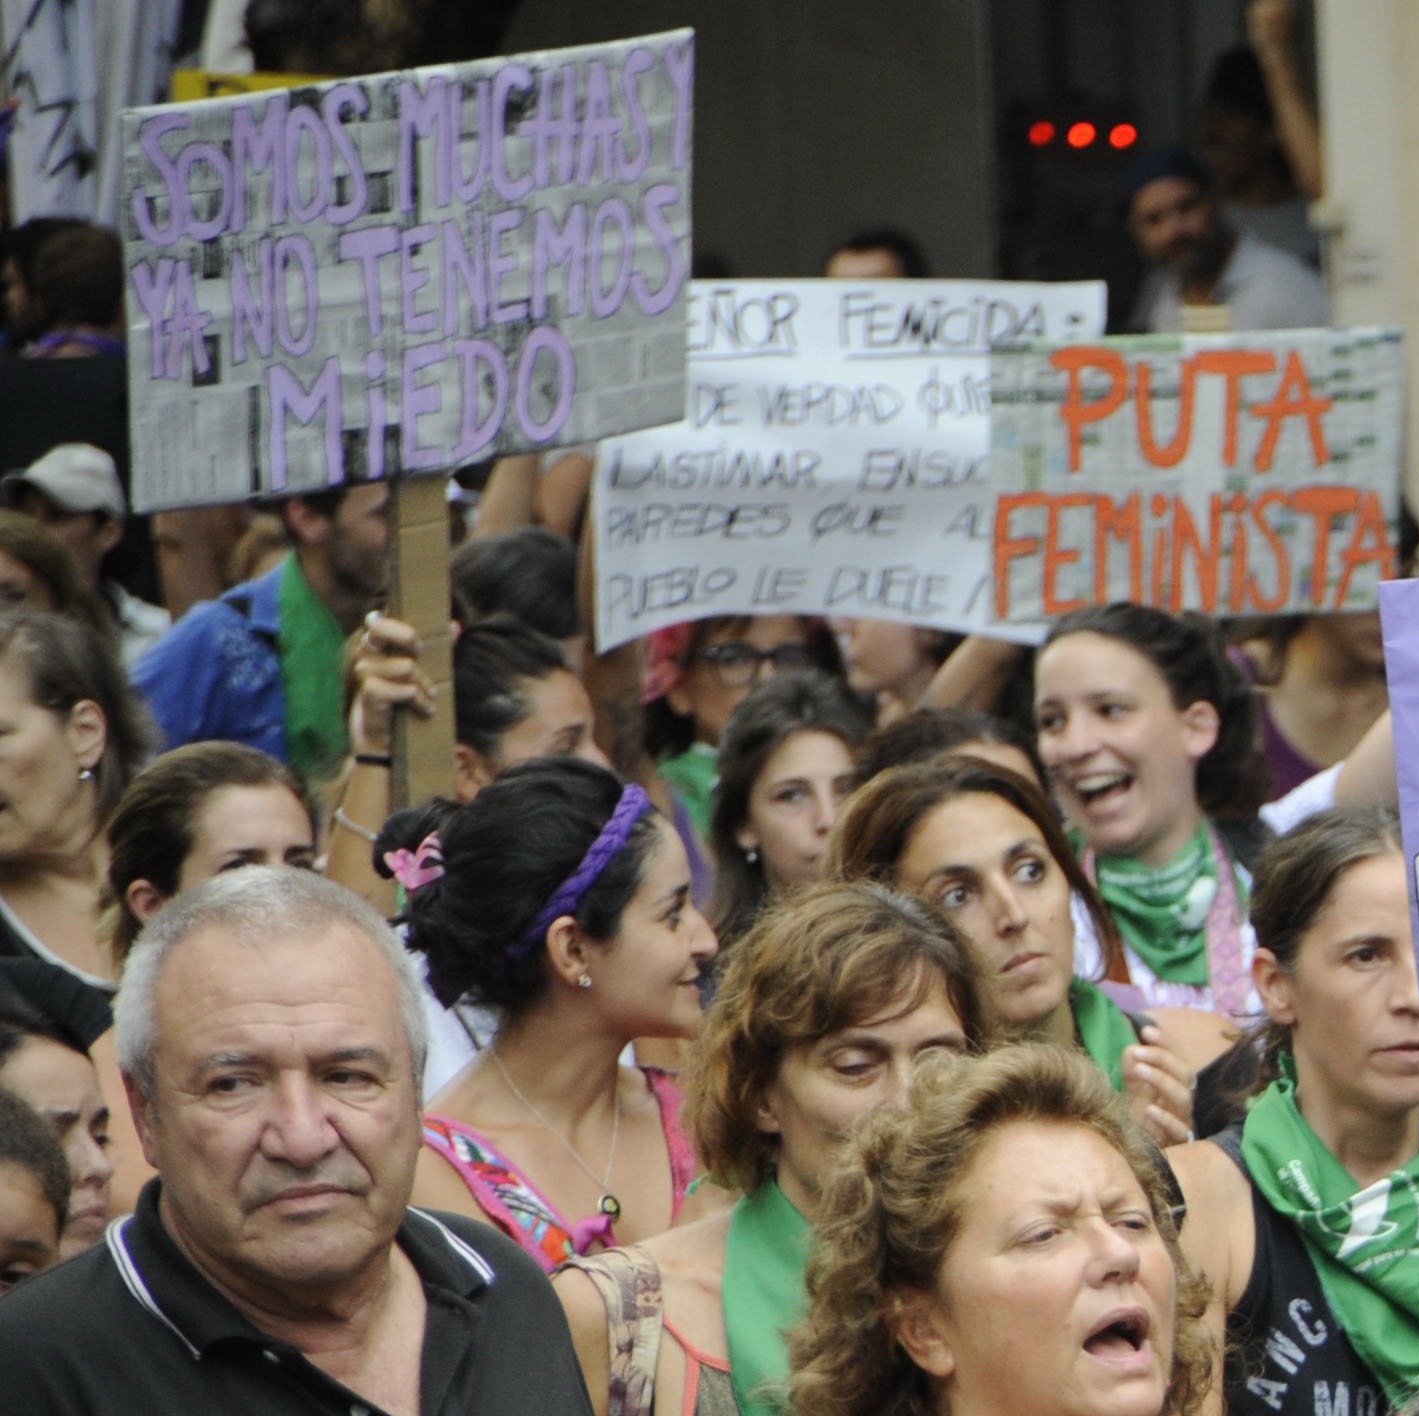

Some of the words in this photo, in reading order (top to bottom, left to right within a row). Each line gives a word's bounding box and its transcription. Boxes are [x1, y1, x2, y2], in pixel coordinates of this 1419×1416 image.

[130, 83, 370, 247] SOMOS
[396, 47, 656, 215] MUCHAS
[131, 257, 213, 381] YA
[230, 232, 319, 366] NO
[339, 184, 688, 338] TENEMOS
[690, 381, 744, 432] DE
[1048, 344, 1334, 474] PUTA
[809, 500, 908, 546] QUE
[750, 563, 809, 606] LE
